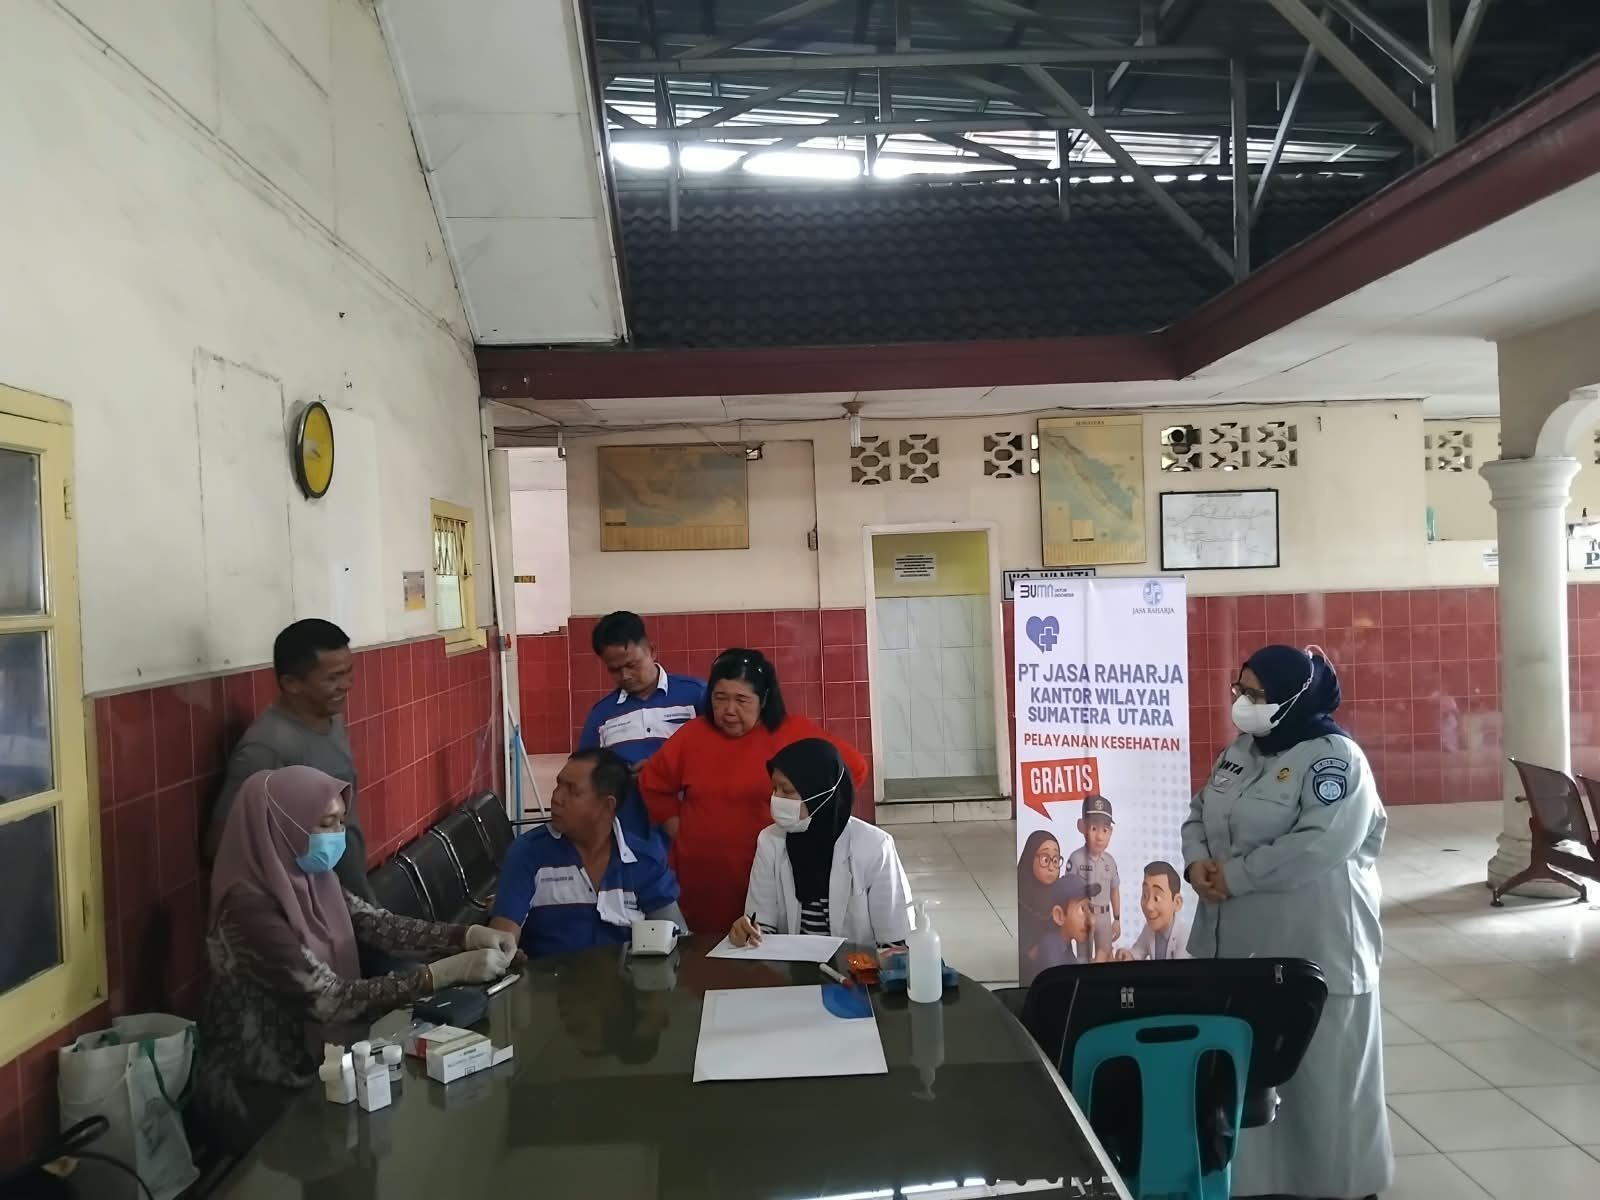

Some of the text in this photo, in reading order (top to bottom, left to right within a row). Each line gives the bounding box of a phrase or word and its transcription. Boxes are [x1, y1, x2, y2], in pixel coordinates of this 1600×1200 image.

[1588, 538, 1600, 551] T
[1132, 607, 1175, 615] JASA RAHARJA
[1018, 663, 1184, 684] PT JASA RAHARJA
[1030, 687, 1170, 706] KANTOR WILAYAH
[1028, 706, 1174, 727] SUMATERA UTARA
[1024, 733, 1180, 751] PELAYANAN KESEHATAN
[1030, 764, 1093, 795] GRATIS
